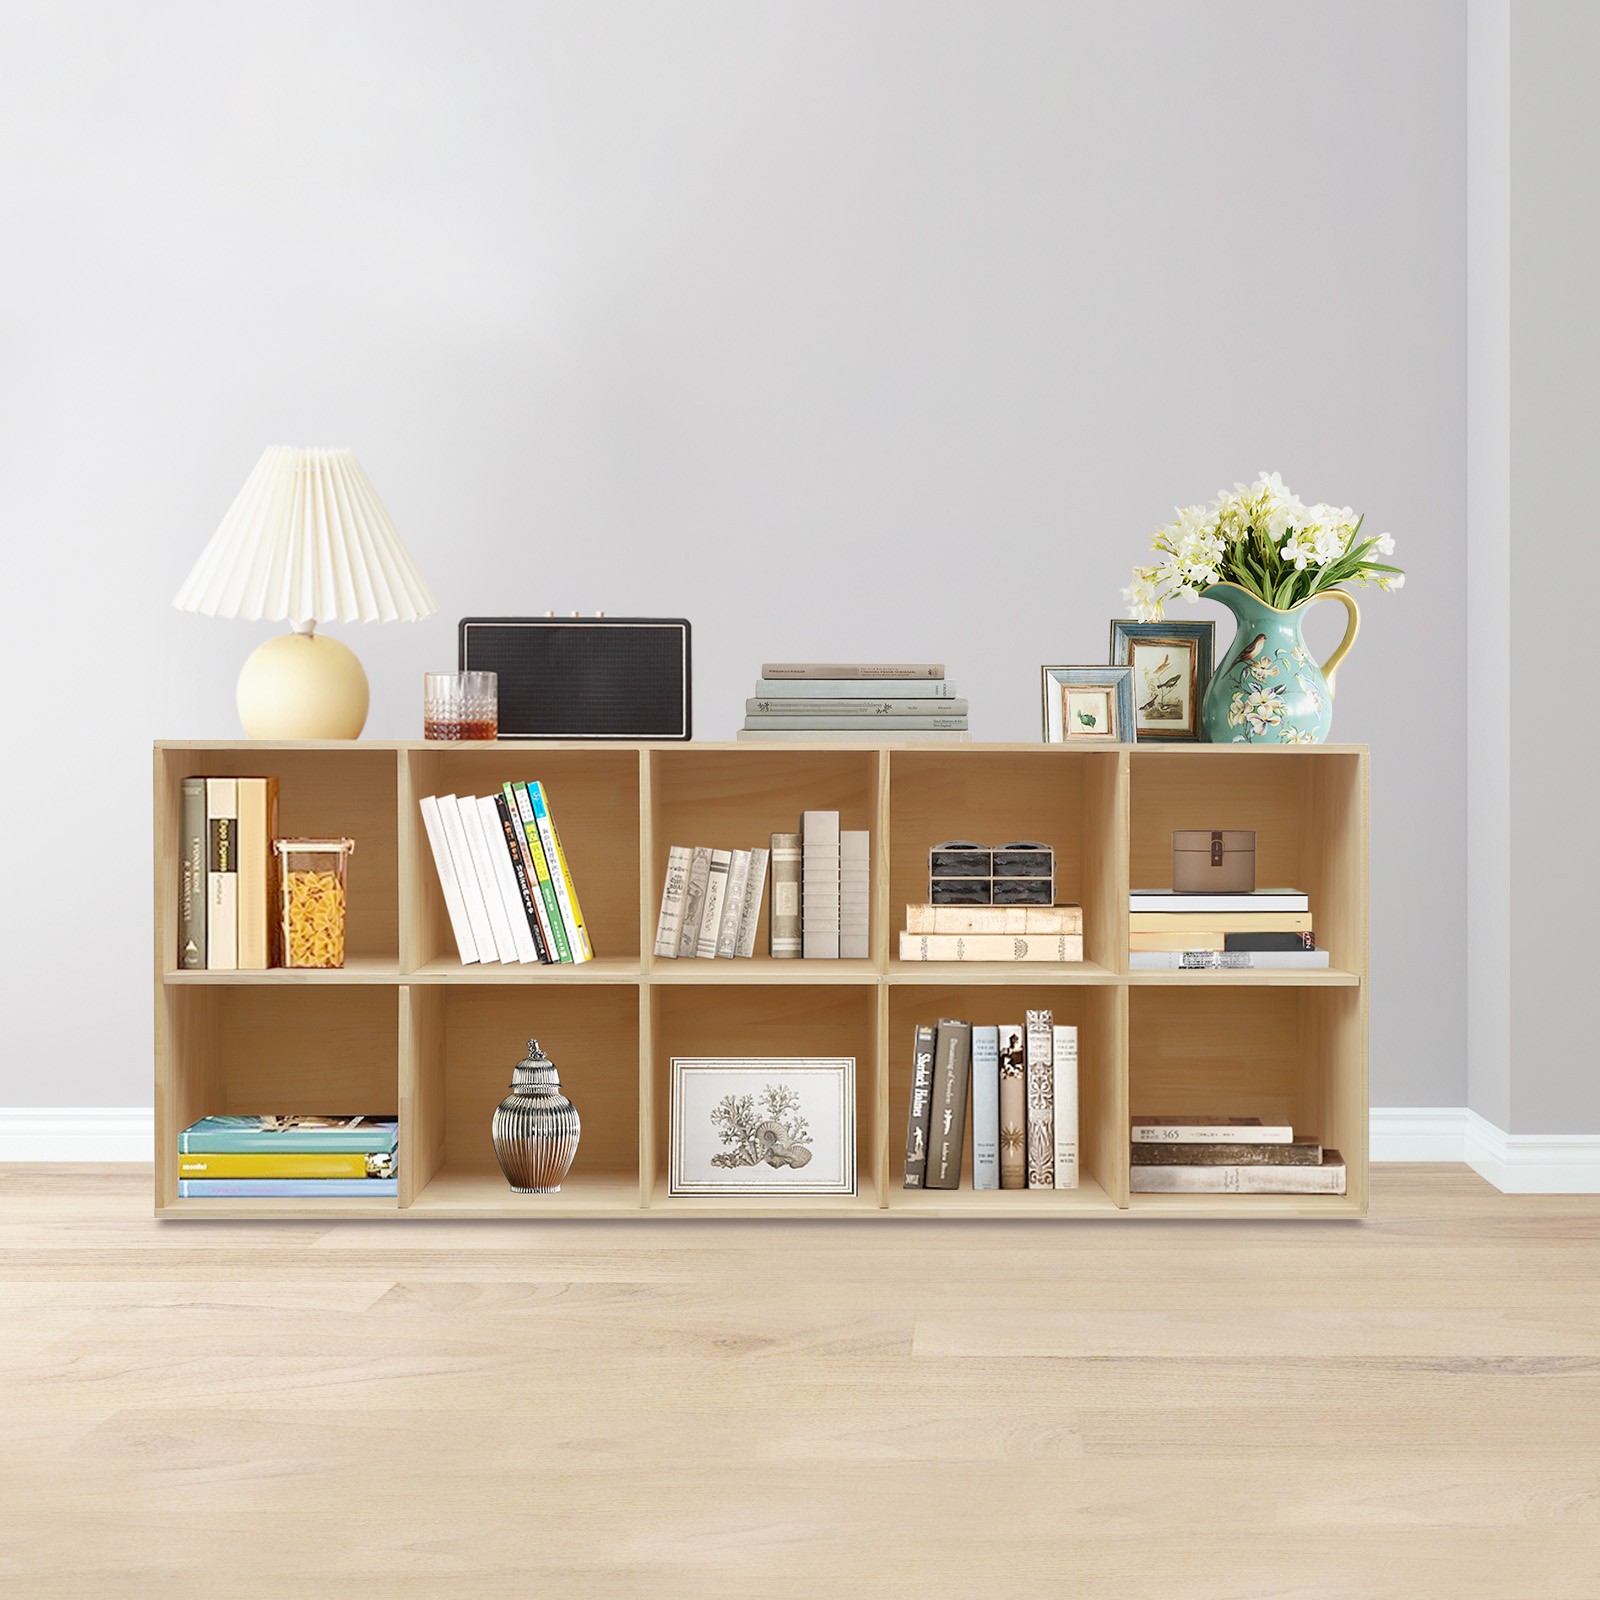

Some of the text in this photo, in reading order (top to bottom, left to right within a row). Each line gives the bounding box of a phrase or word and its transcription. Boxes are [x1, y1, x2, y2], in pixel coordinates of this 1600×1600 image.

[913, 1052, 931, 1118] Sherlock Holmes
[1162, 1129, 1179, 1140] 365
